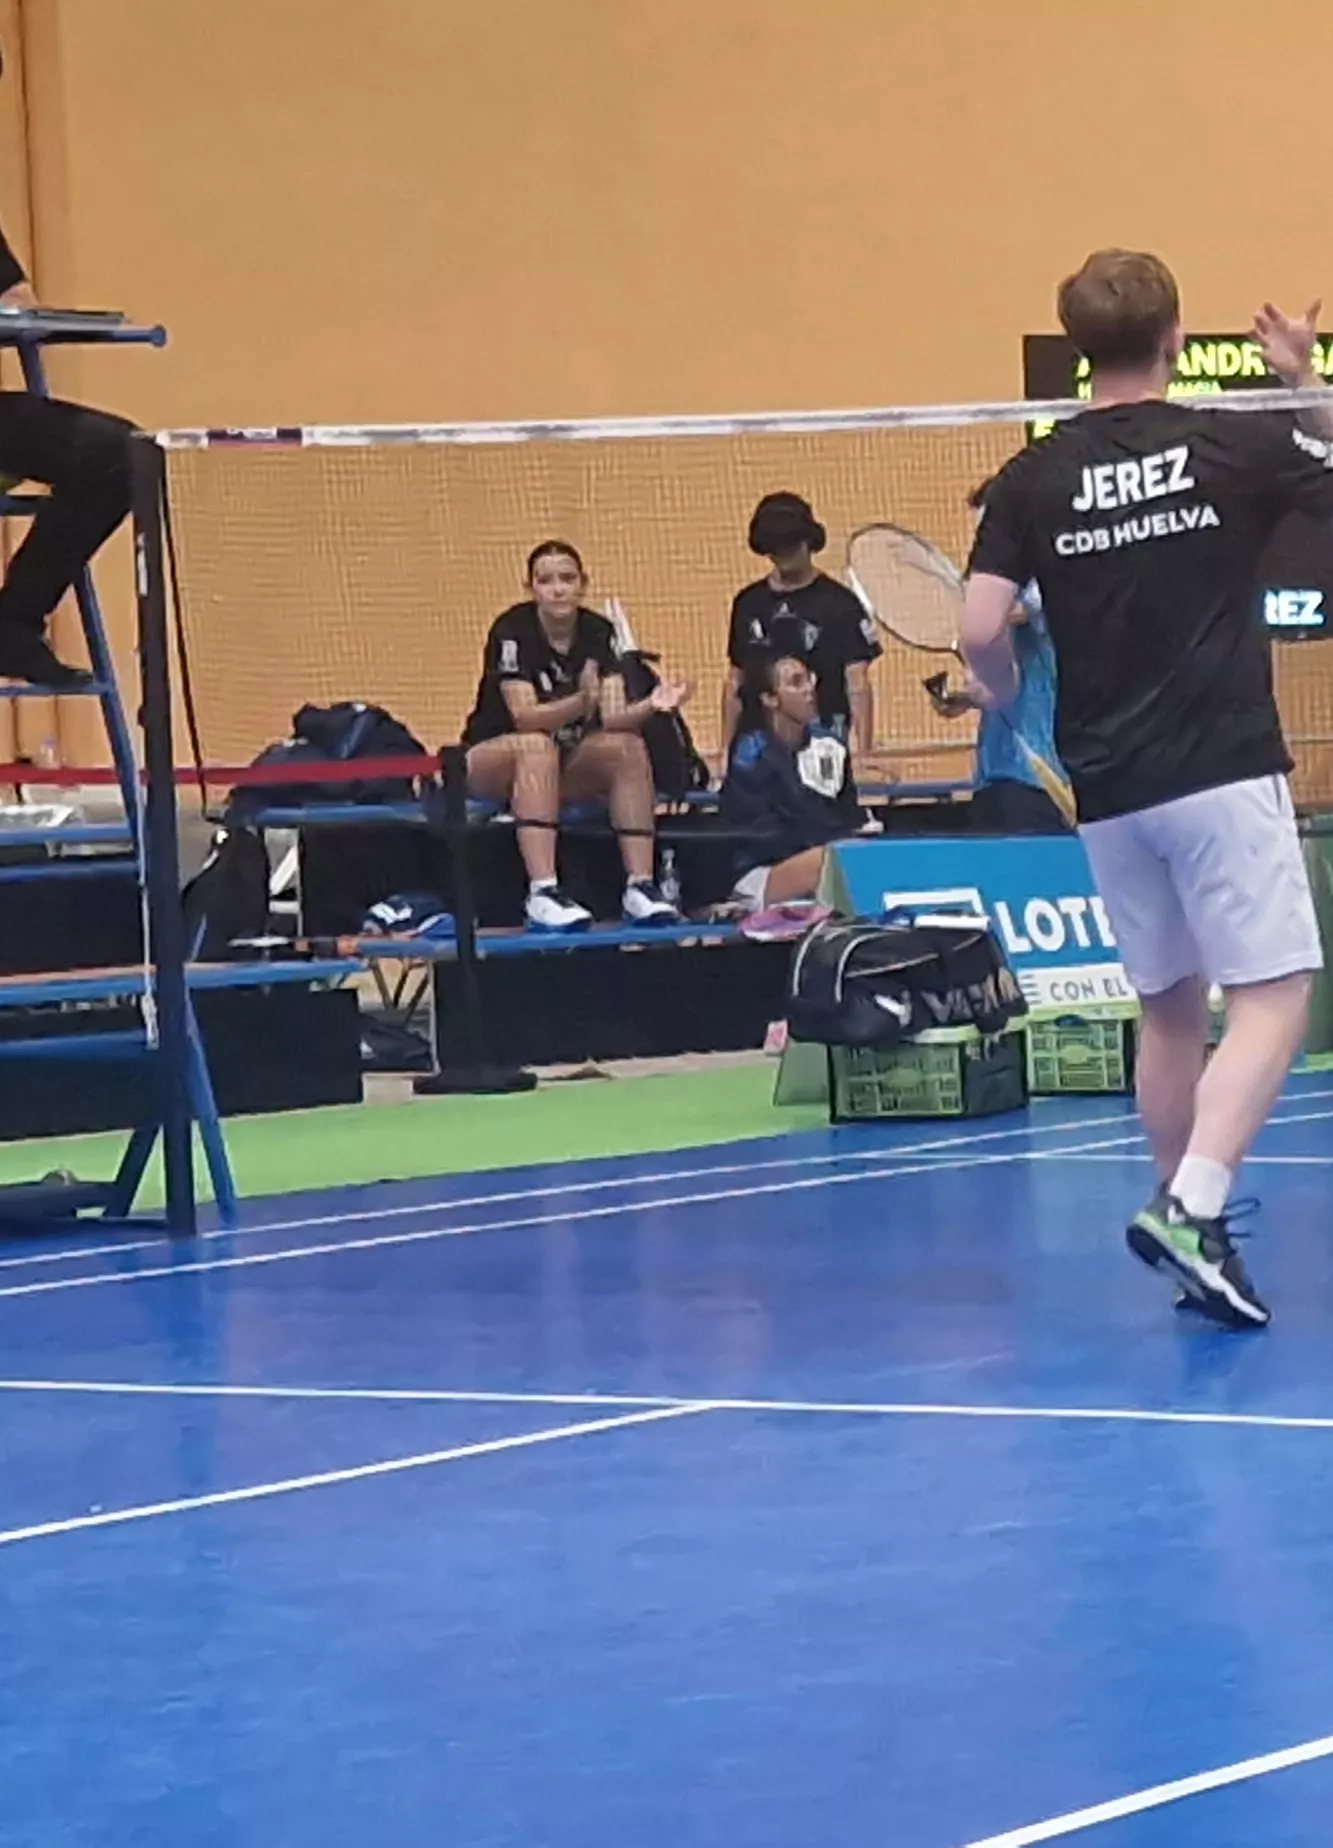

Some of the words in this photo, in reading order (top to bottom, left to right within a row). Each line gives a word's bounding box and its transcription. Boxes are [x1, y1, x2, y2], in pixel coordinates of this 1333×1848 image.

[1072, 445, 1195, 512] JEREZ
[1055, 529, 1111, 556] CDB
[1113, 503, 1220, 548] HUELVA
[1265, 590, 1324, 625] REZ
[1049, 979, 1097, 1002] CON
[1102, 976, 1129, 998] EL
